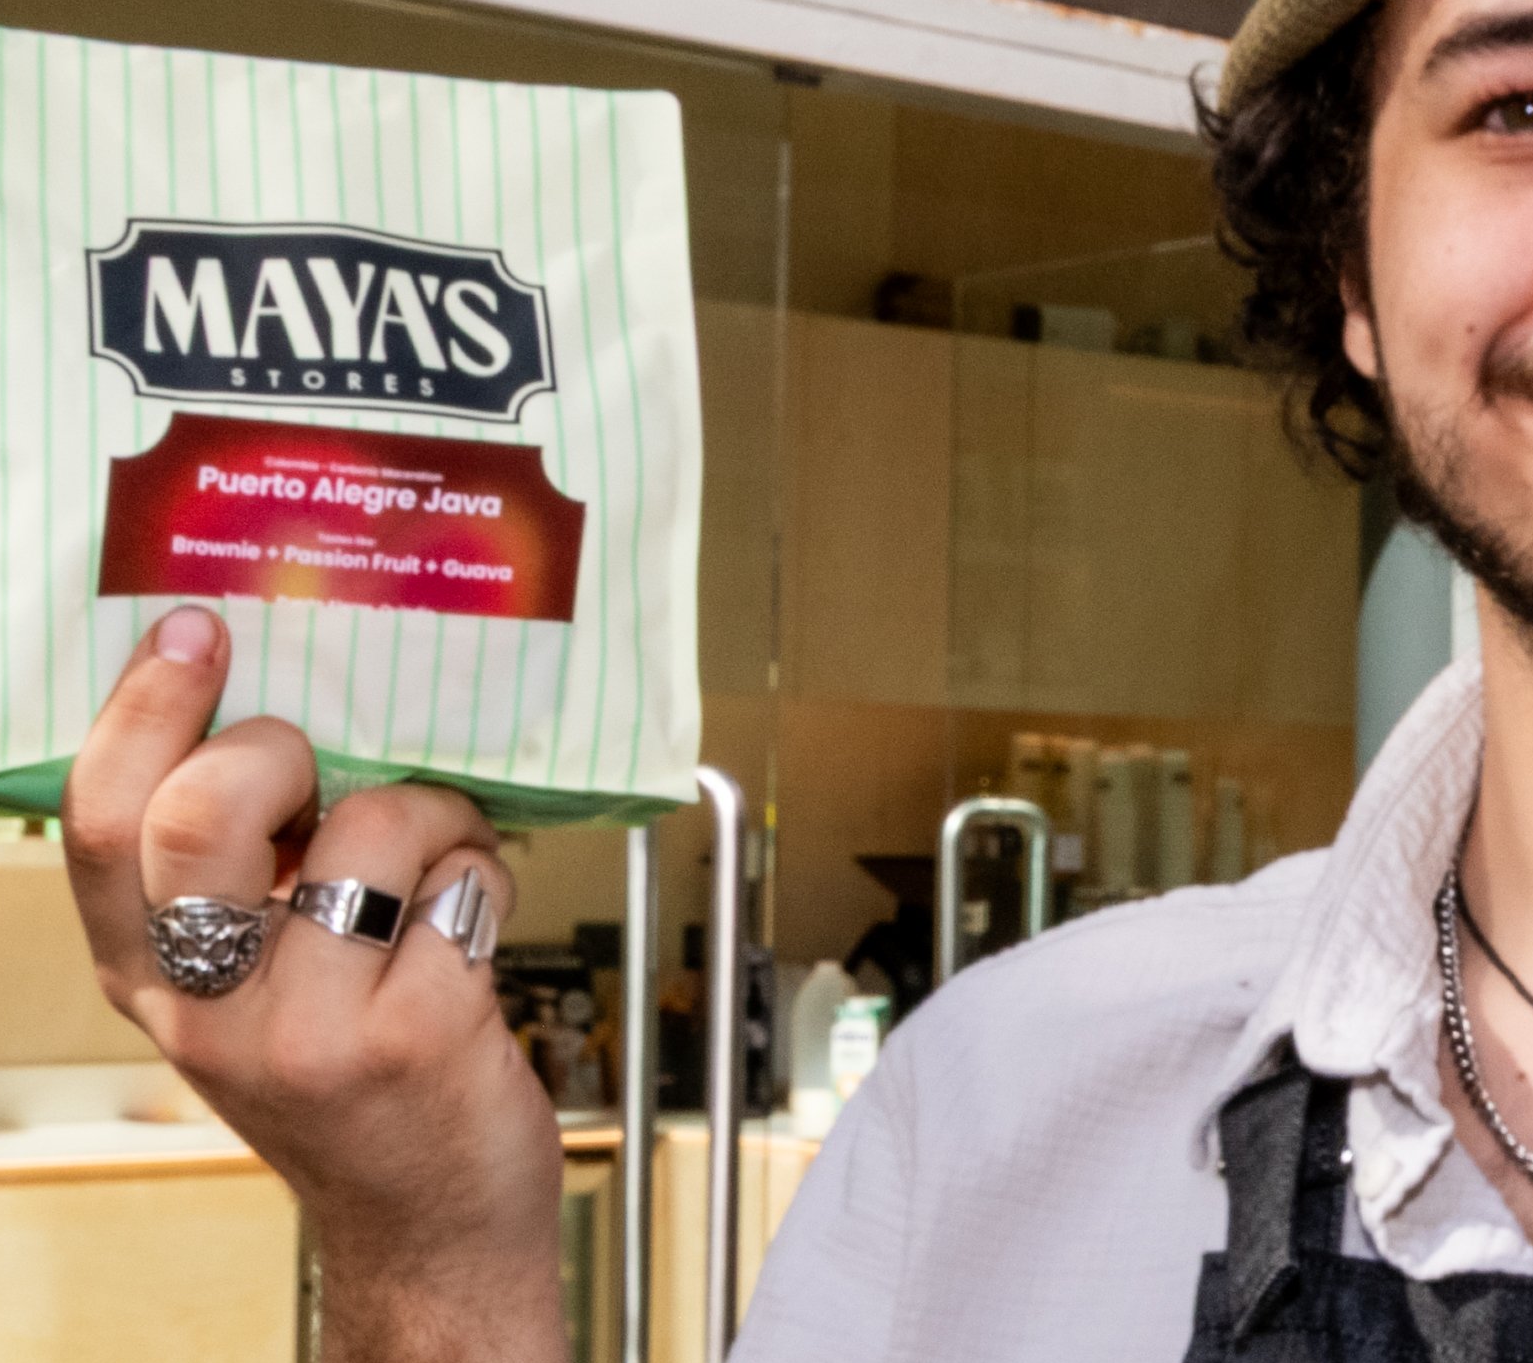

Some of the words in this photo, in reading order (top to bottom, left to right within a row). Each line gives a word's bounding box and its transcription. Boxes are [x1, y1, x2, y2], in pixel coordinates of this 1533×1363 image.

[144, 255, 512, 378] MAYA'S
[229, 367, 436, 397] STORES
[197, 465, 306, 500] Puerto
[311, 476, 417, 515] Alegre
[423, 487, 503, 518] Java
[171, 535, 261, 561] Brownie
[283, 545, 369, 570] Passion
[372, 553, 421, 575] Fruit
[441, 558, 514, 582] Guava
